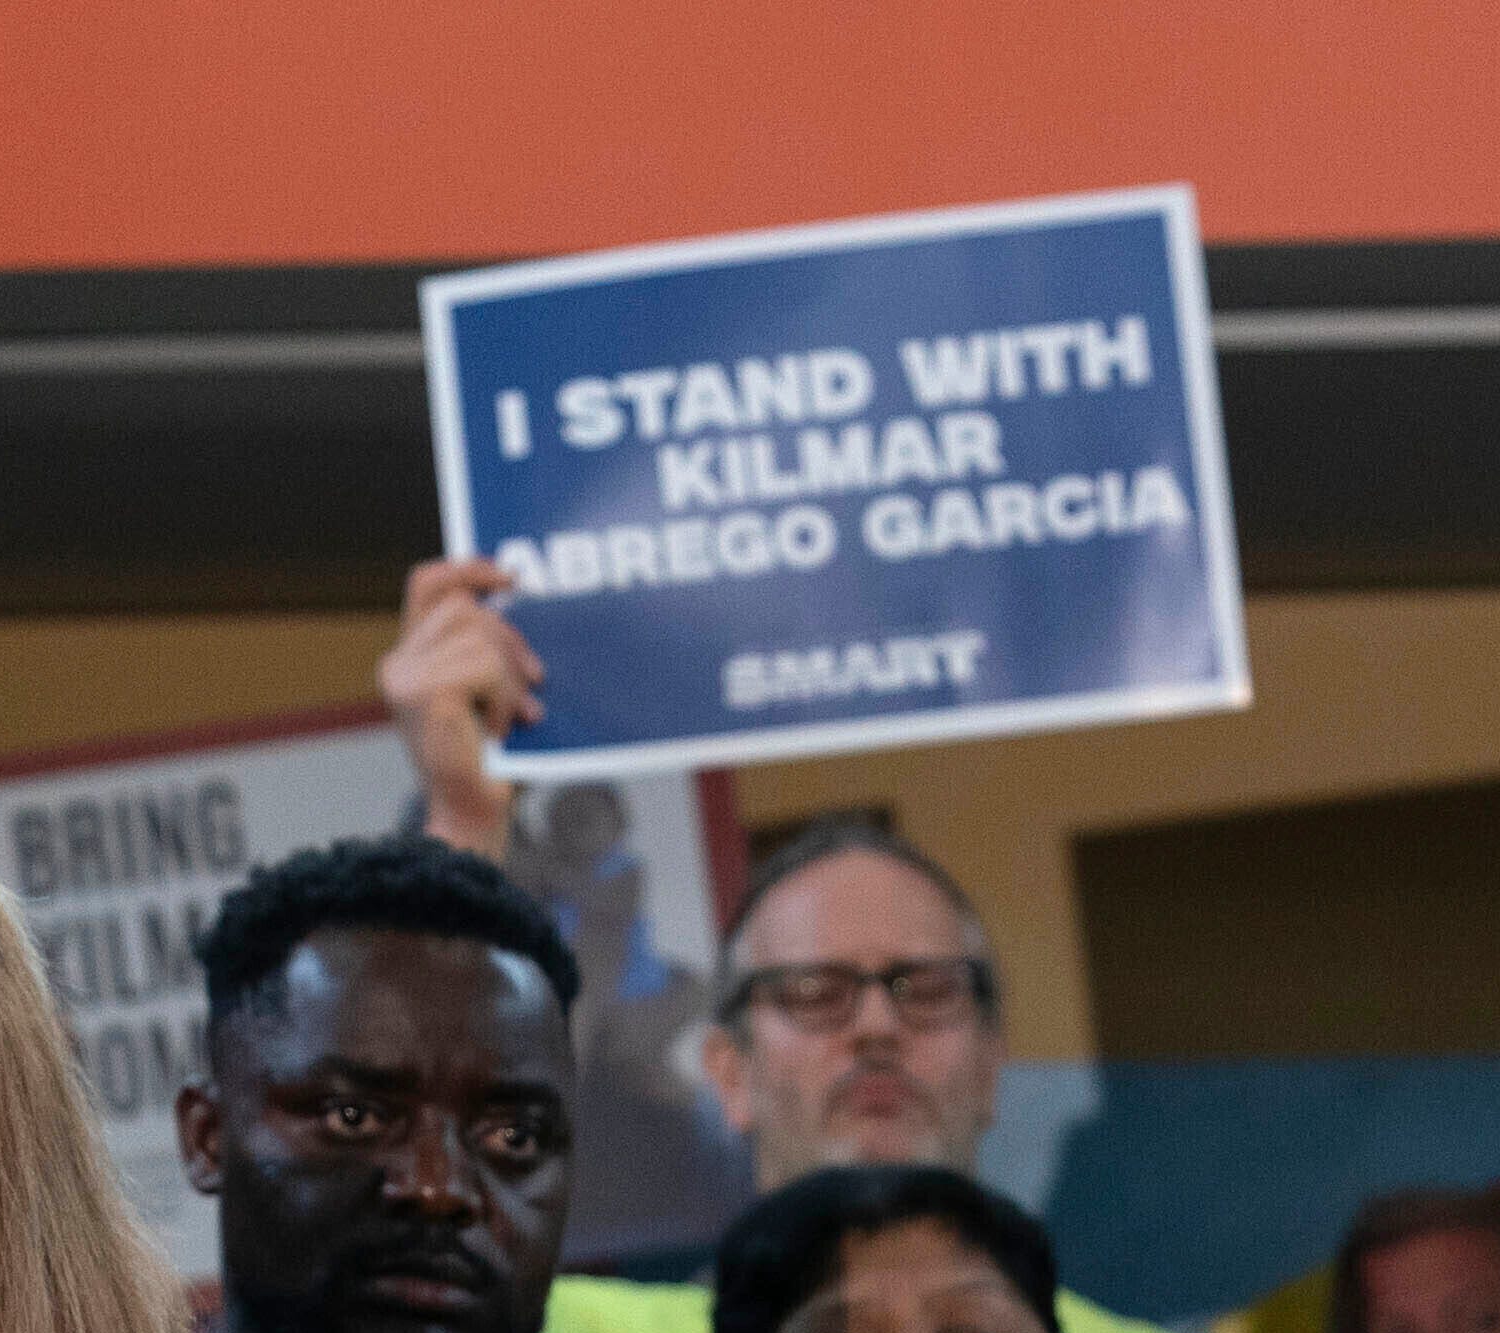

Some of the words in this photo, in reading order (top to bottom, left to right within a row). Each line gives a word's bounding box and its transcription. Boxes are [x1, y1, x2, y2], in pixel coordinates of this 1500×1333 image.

[497, 390, 530, 458] I
[558, 347, 875, 450] STAND
[900, 315, 1153, 407] WITH
[657, 411, 1004, 511] KILMAR
[498, 504, 838, 599] ABREGO
[861, 465, 1192, 560] GARCIA
[722, 630, 987, 708] SMART
[12, 778, 246, 898] BRING
